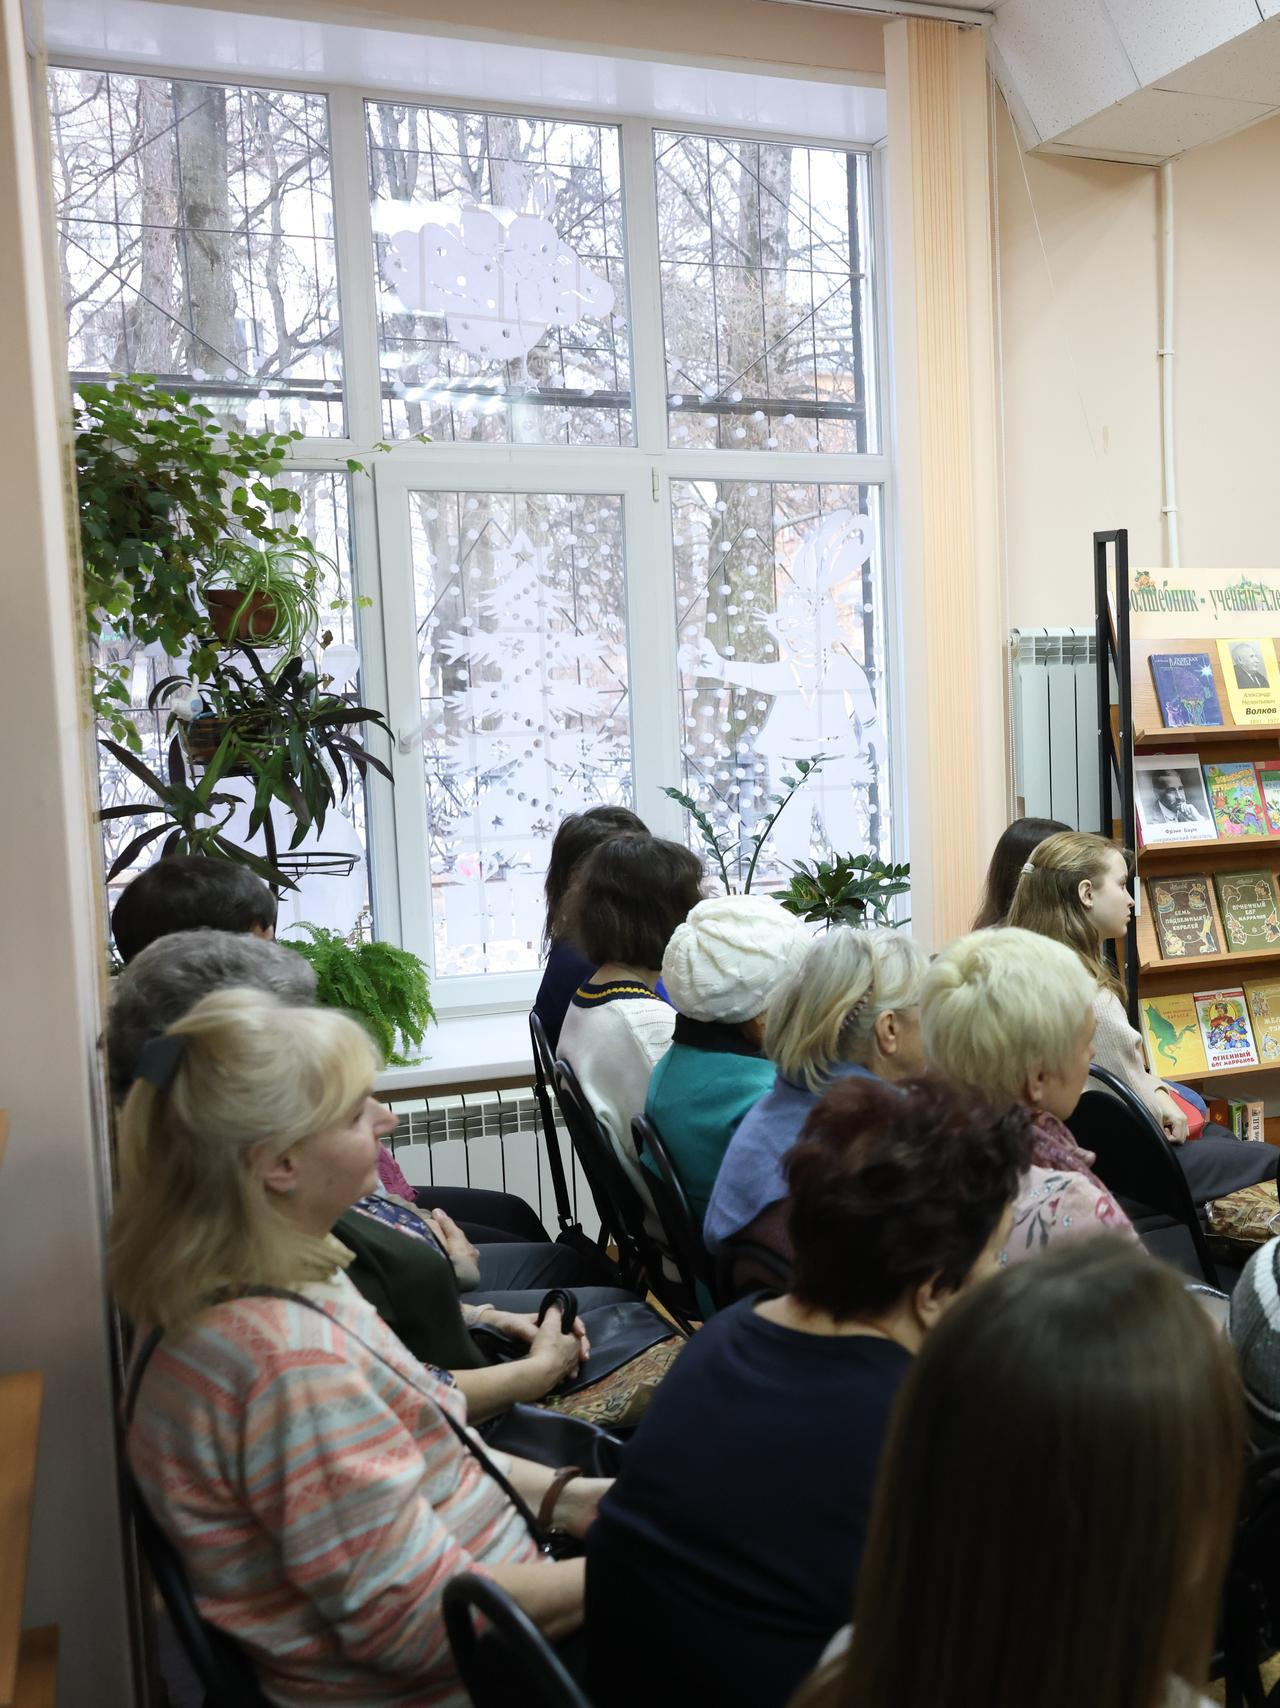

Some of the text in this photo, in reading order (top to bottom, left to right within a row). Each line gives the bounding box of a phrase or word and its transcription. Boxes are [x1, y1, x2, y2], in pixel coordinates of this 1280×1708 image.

[1129, 580, 1199, 613] олшебник
[1245, 707, 1278, 716] Волков
[1232, 901, 1266, 910] ОГНЕННЫЙ
[1165, 916, 1204, 924] ПОДЗЕМНЫХ
[1212, 1050, 1252, 1062] ОГНЕННЫЙ
